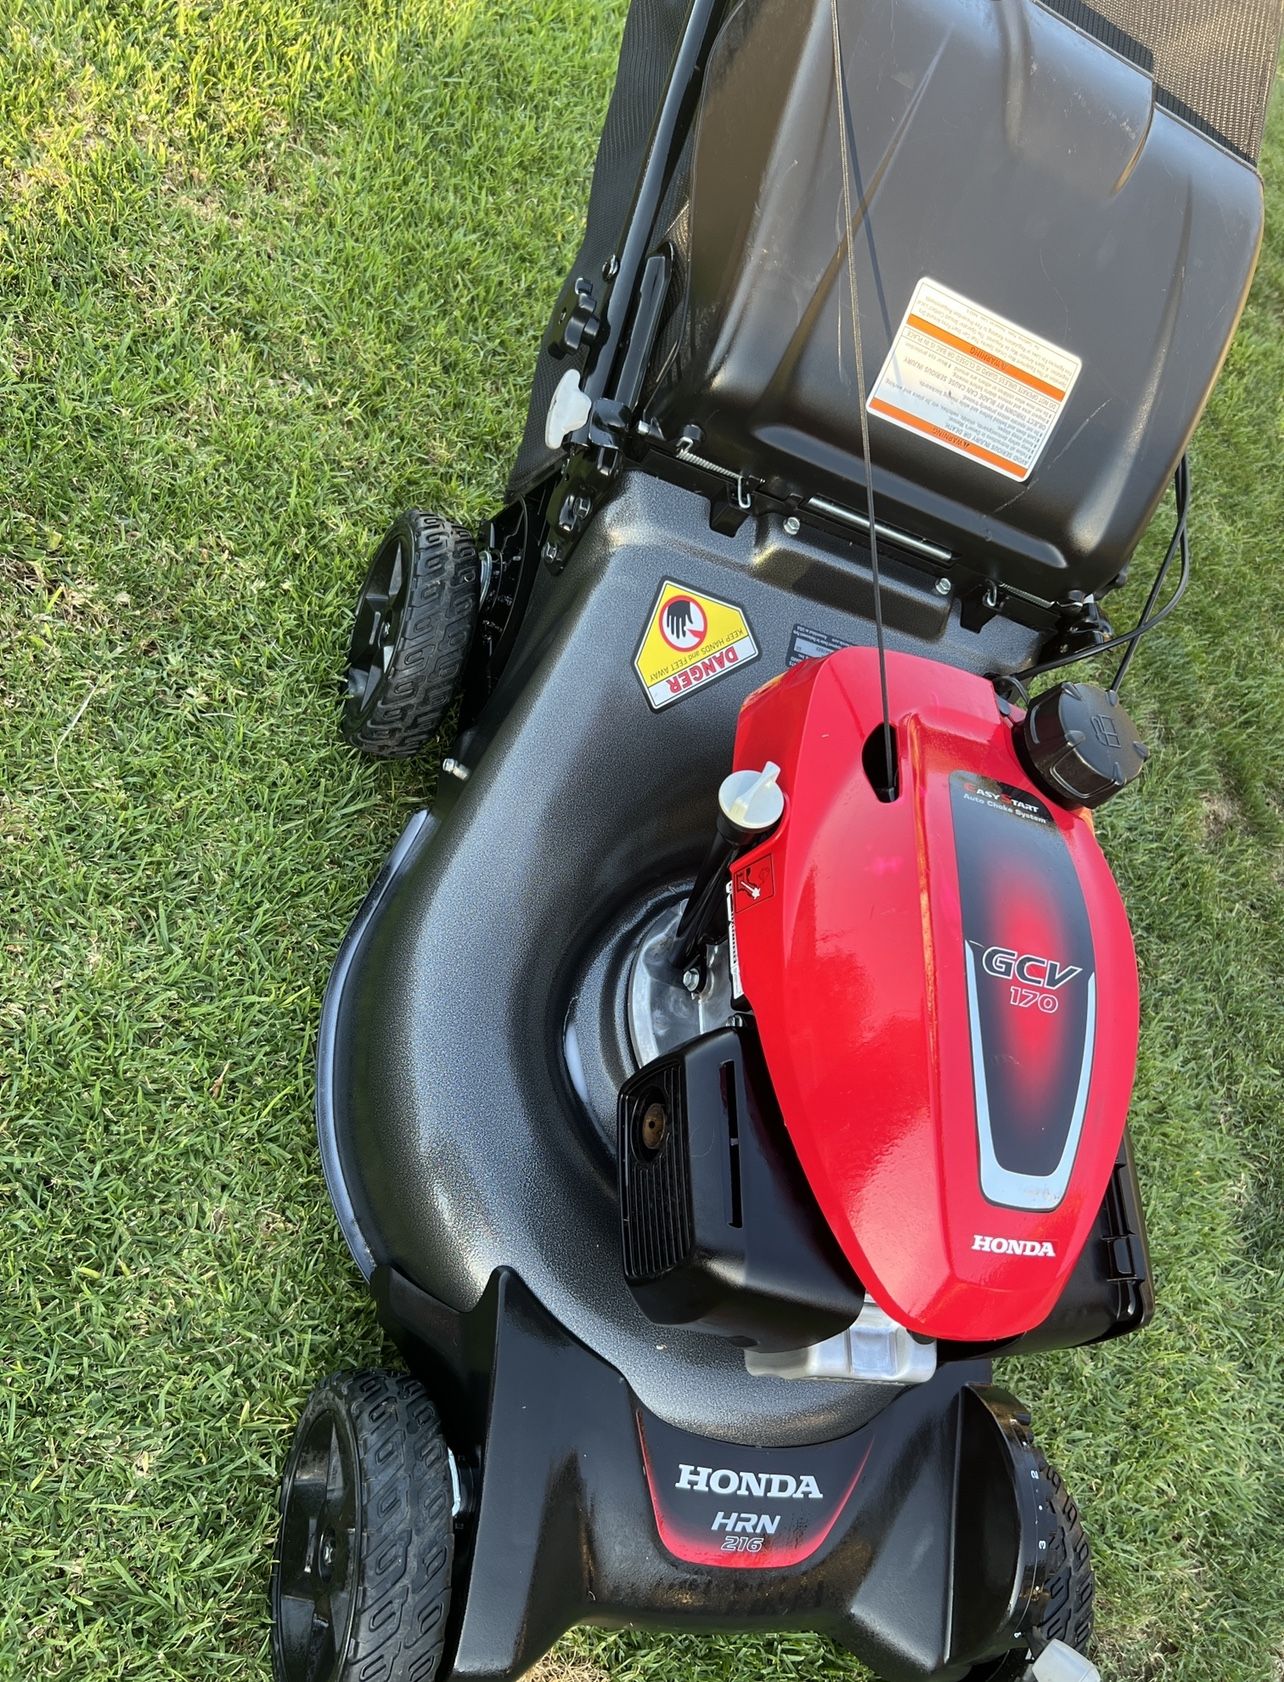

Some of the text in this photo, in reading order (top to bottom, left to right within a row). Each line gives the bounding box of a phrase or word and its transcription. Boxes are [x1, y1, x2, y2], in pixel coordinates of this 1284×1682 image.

[969, 345, 1002, 368] WARNING
[931, 427, 964, 447] WARNING
[650, 628, 743, 682] KEEP HANDS and FEET AWAY
[666, 646, 738, 694] DANGER
[963, 793, 1046, 824] Auto Choke System
[982, 946, 1083, 990] GCV
[1010, 986, 1058, 1014] 170
[971, 1235, 1056, 1257] HONDA
[675, 1464, 823, 1498] HONDA
[711, 1511, 781, 1534] HRN
[721, 1536, 764, 1552] 216
